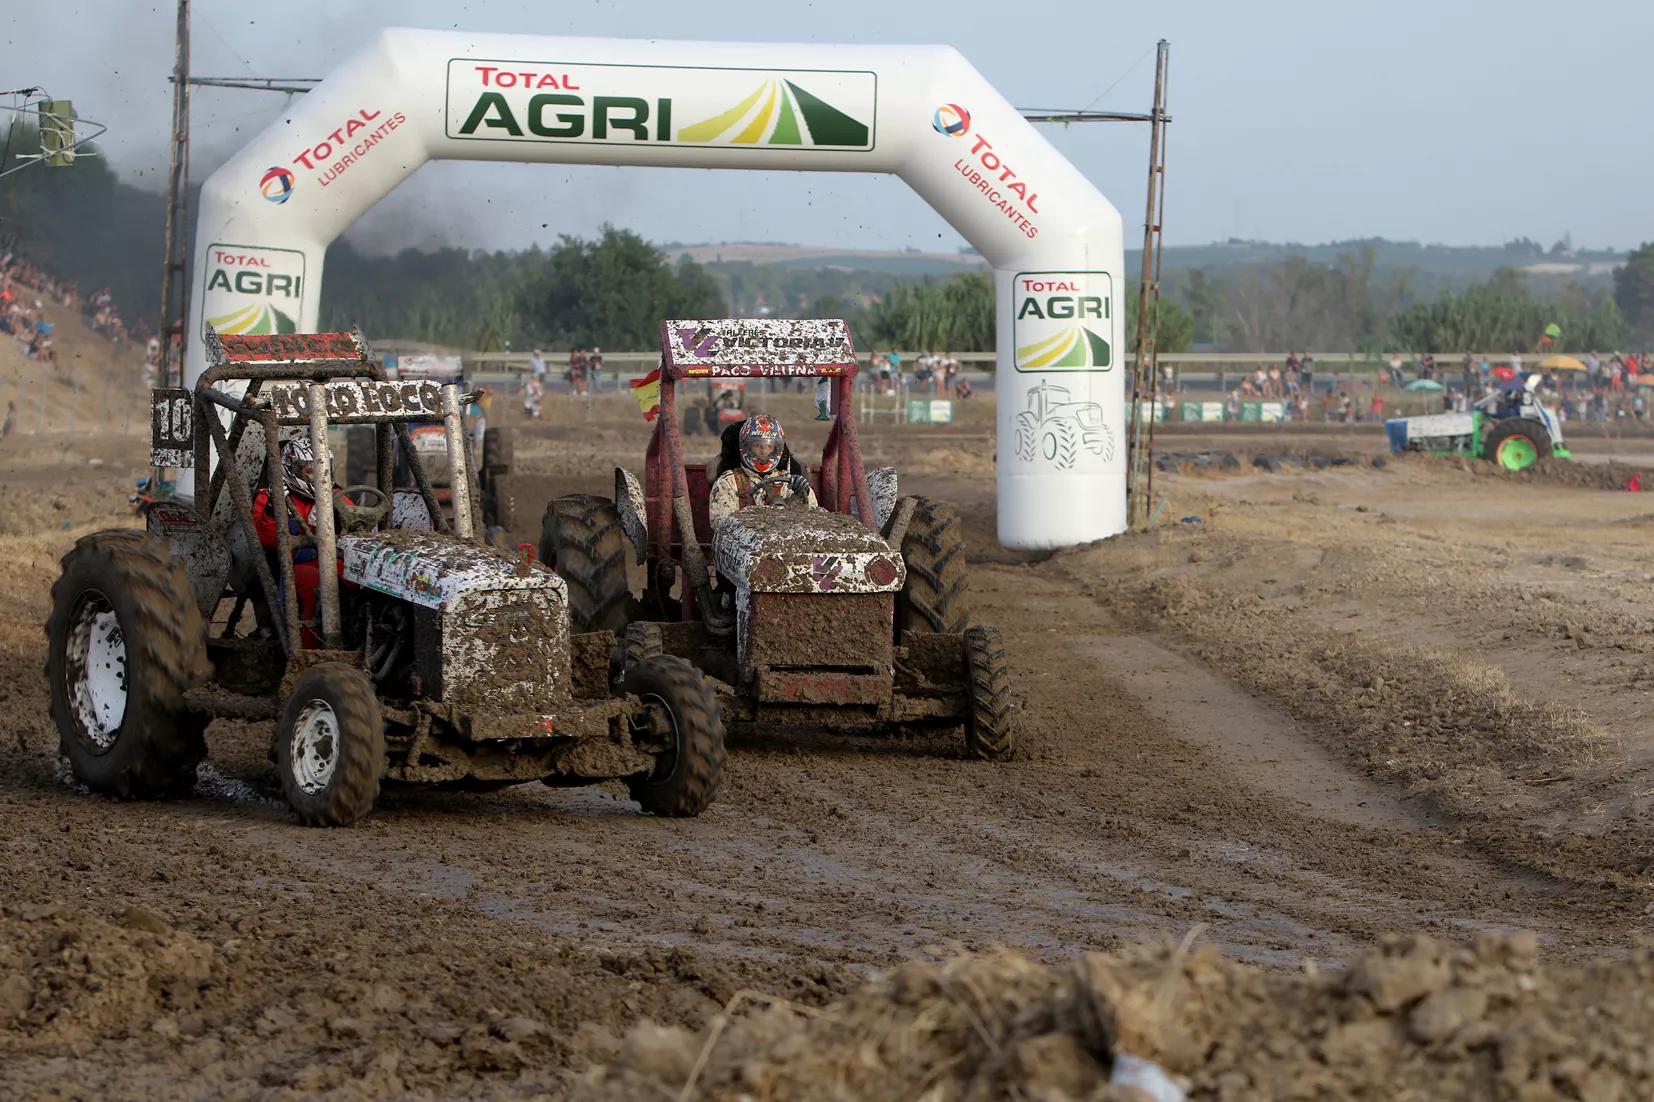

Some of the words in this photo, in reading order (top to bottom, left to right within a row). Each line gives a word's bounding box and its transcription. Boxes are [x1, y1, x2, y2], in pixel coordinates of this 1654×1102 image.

[475, 66, 580, 90] TOTAL
[458, 91, 672, 142] AGRI
[293, 109, 381, 170] TOTAL
[317, 112, 407, 187] LUBRICANTES
[971, 133, 1038, 214] TOTAL
[954, 158, 1038, 239] LUBRICANTES
[215, 251, 270, 268] TOTAL
[207, 268, 301, 298] AGRI
[1022, 279, 1081, 292] TOTAL
[1017, 296, 1110, 320] AGRI
[711, 366, 752, 376] PACO
[155, 398, 192, 442] 10
